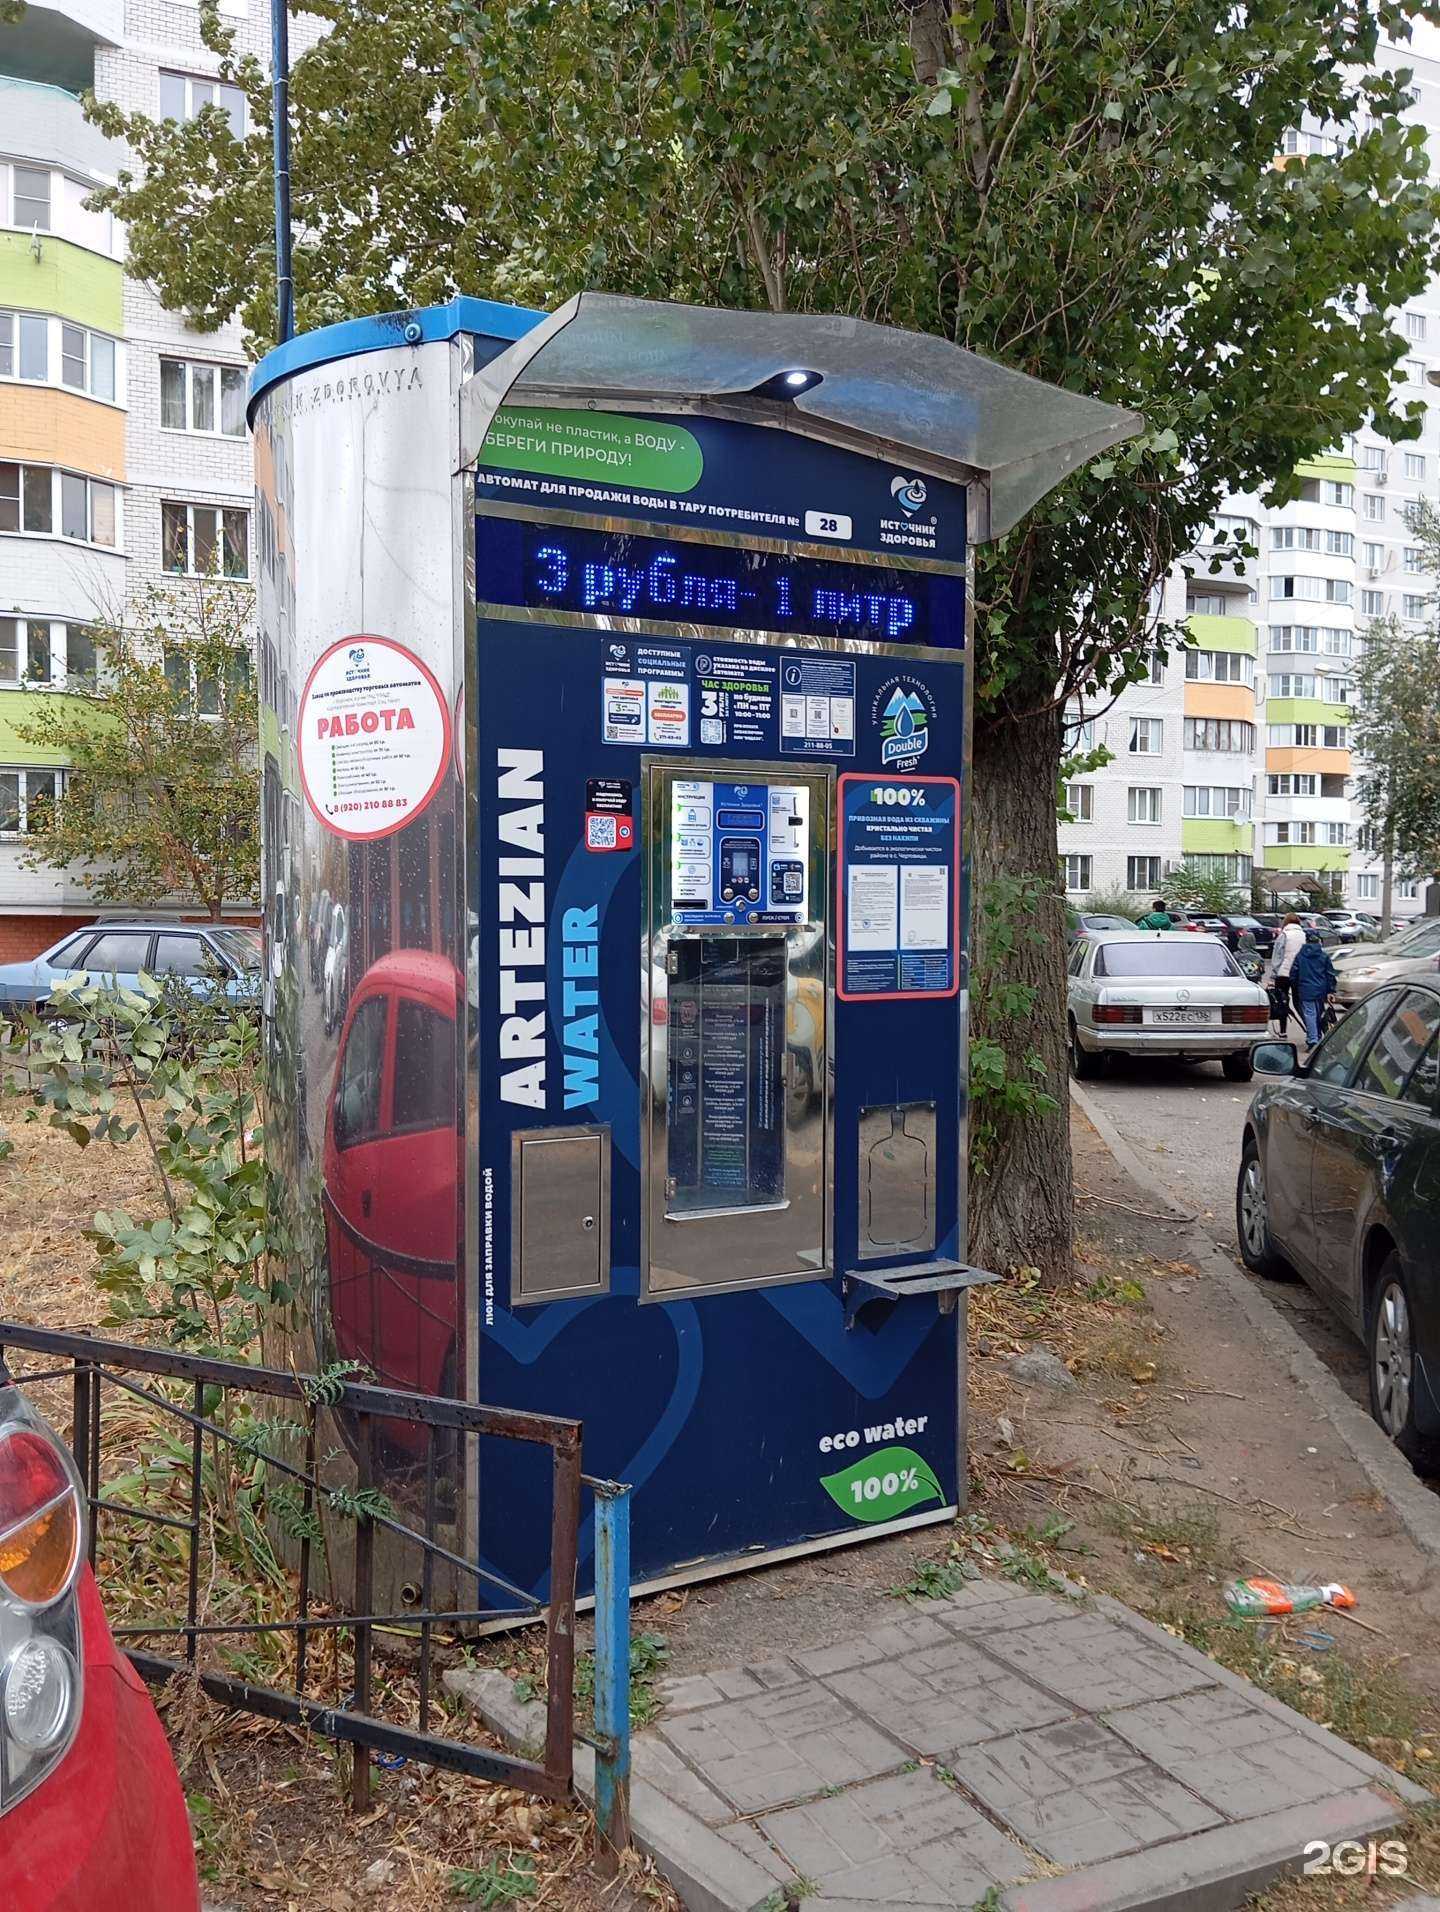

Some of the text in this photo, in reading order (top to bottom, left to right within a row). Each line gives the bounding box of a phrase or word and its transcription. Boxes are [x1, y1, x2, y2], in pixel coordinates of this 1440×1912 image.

[494, 414, 543, 431] окупай
[547, 421, 562, 433] не
[566, 425, 621, 445] пластик,
[624, 435, 631, 444] а
[635, 434, 676, 452] ВОДУ
[486, 431, 632, 466] БЕРЕГИ ПРИРОДУ!
[477, 473, 838, 532] АВТОМАТ ДЛЯ ПРОДАЖИ ВОДЫ В ТАРУ ПОТРЕБИТЕЛЯ № 28
[880, 533, 936, 548] ЗДОРОВЬЯ
[537, 547, 567, 592] 3
[776, 577, 793, 616] 1
[637, 648, 681, 658] ДОСТУПНЫЕ
[637, 657, 686, 668] СОЦИАЛЬНЫЕ
[637, 667, 685, 677] ПРОГРАММЫ
[702, 679, 769, 693] ЧАС ЗДОРОВЬЯ
[700, 691, 719, 717] 3
[737, 702, 749, 710] ПН
[759, 703, 770, 711] ПТ
[872, 676, 900, 726] УНИКАЛЬНАЯ
[902, 675, 938, 719] ТЕХНОЛОГИЯ
[317, 708, 415, 739] РАБОТА
[888, 738, 922, 754] Double
[896, 757, 918, 769] Fresh
[334, 798, 408, 813] 8 (920) 210 88 83
[873, 787, 926, 806] 100%
[497, 748, 546, 1110] ARTEZIAN
[563, 904, 600, 1110] WATER
[483, 1168, 494, 1326] ЛЮК ДЛЯ ЗАПРАВКИ ВОДОЙ
[819, 1416, 928, 1453] eco water
[851, 1467, 919, 1503] 100%
